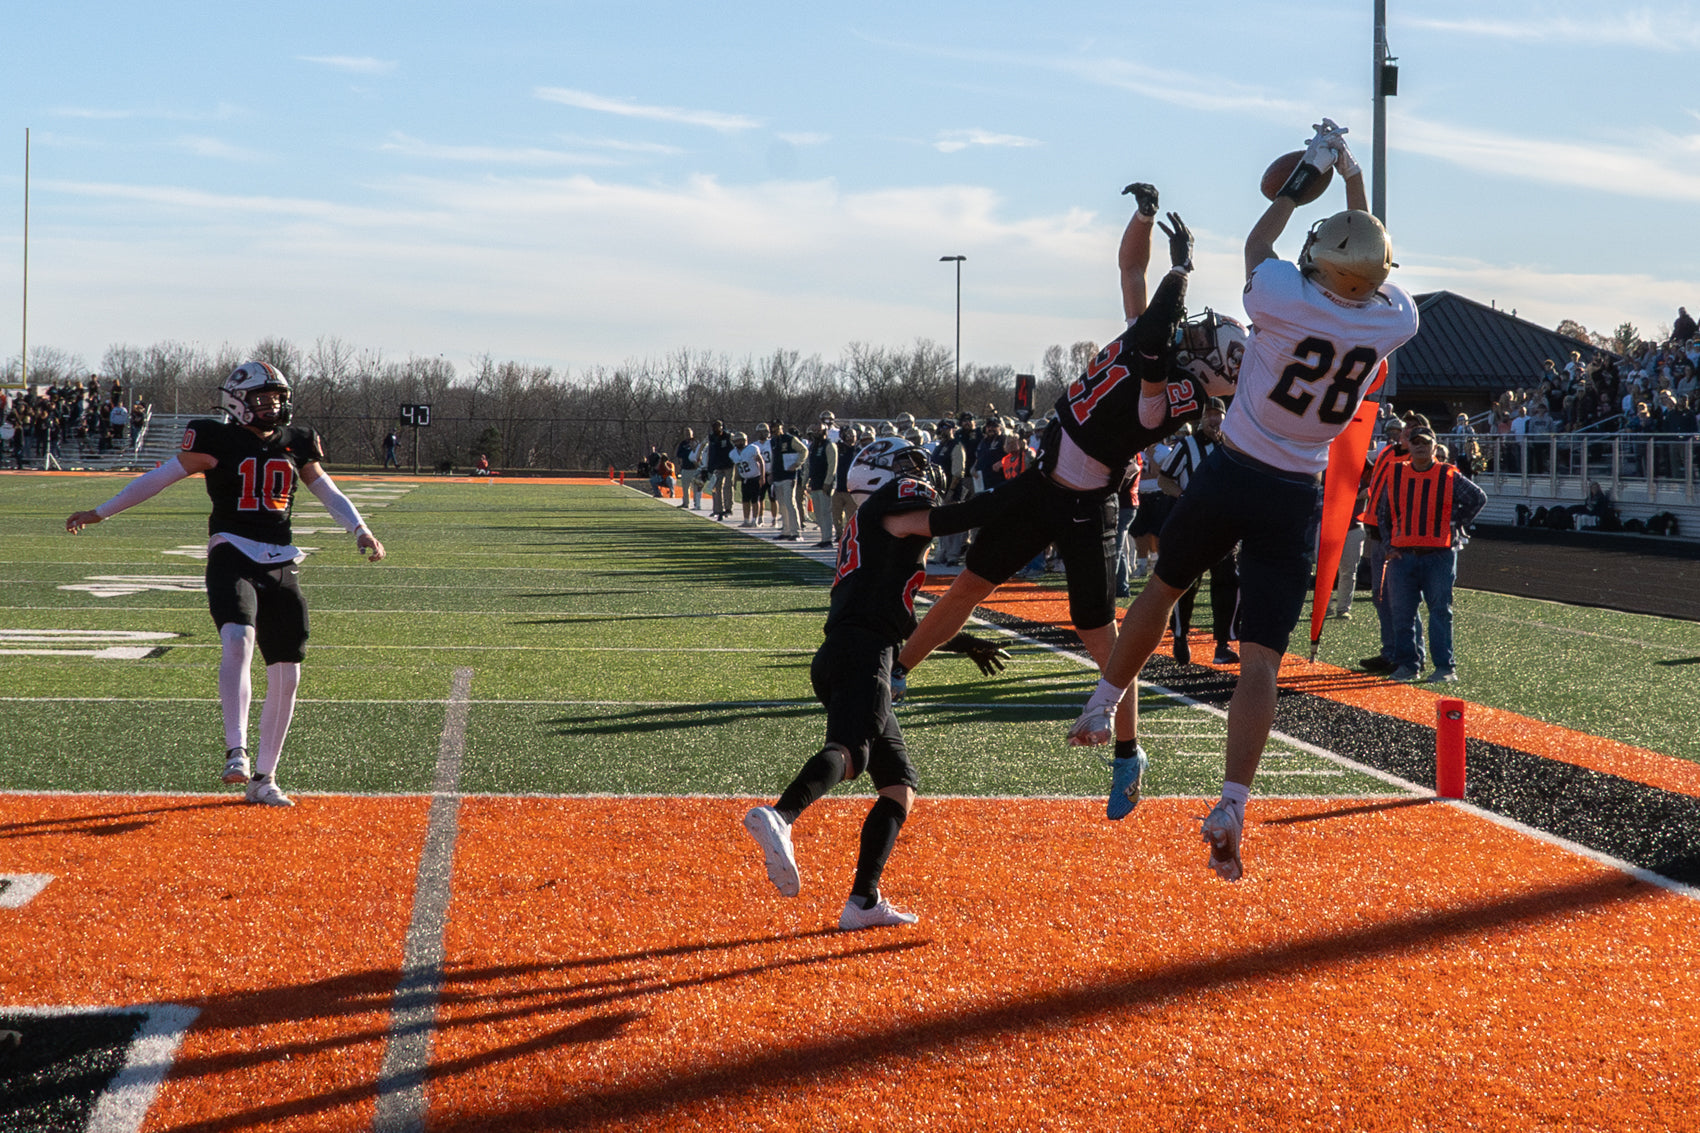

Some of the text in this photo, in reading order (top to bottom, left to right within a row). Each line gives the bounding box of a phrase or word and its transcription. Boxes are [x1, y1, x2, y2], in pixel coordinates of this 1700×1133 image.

[1068, 340, 1130, 426] 21
[1166, 379, 1198, 418] 21
[1269, 336, 1378, 425] 28
[237, 457, 294, 511] 10
[897, 477, 938, 500] 23
